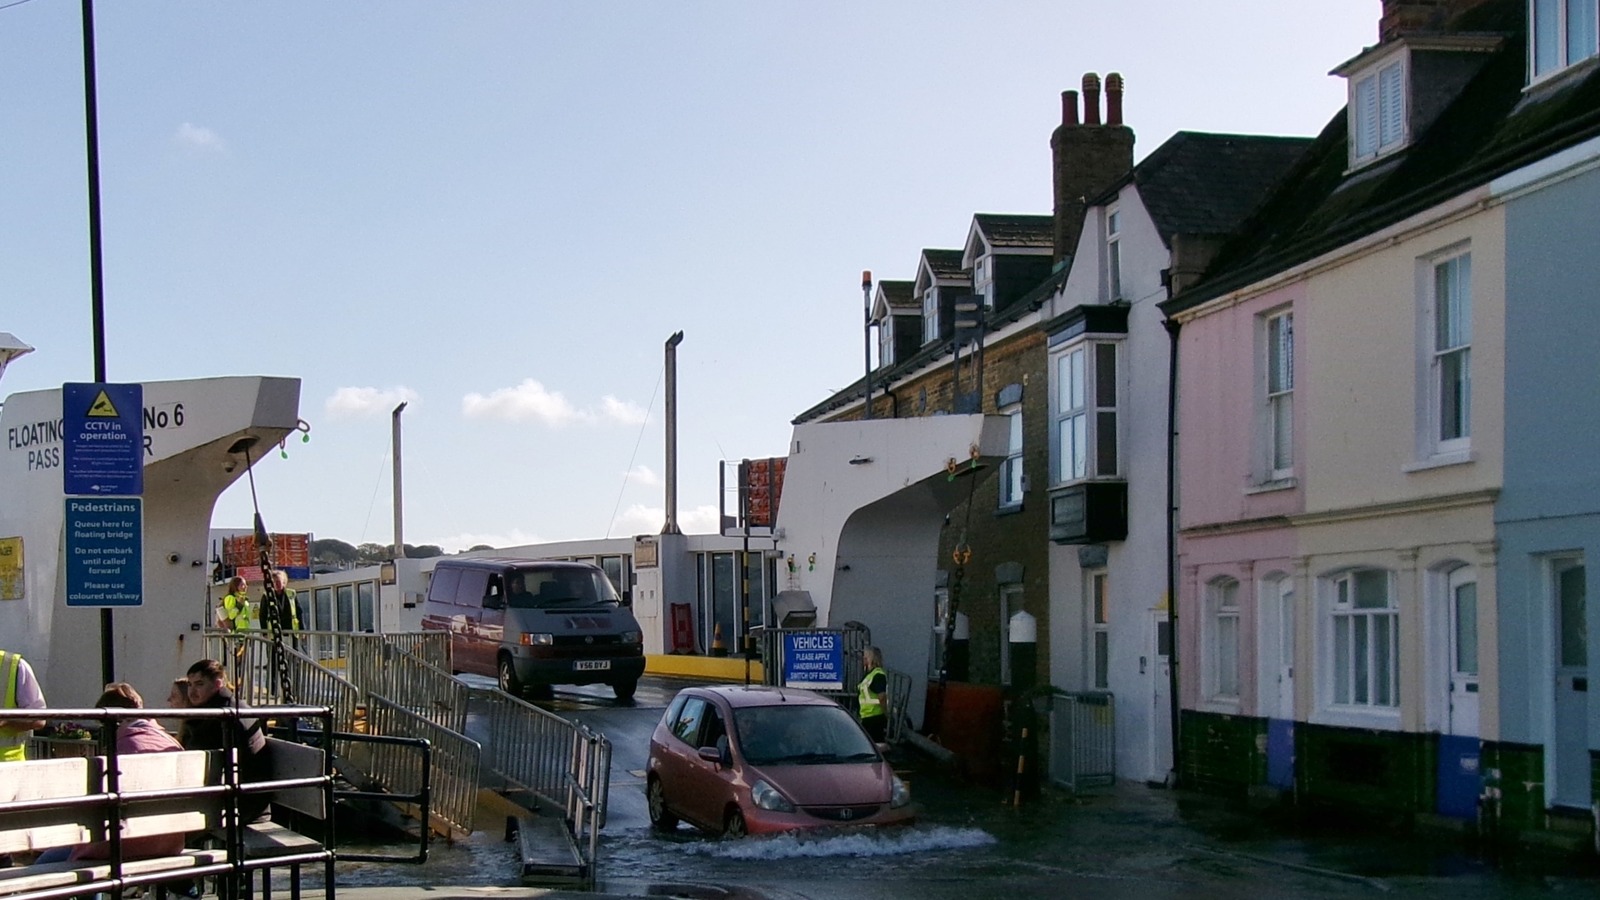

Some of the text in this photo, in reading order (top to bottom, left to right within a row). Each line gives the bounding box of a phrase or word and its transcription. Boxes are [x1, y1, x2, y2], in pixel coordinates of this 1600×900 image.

[143, 406, 168, 430] No
[174, 403, 184, 427] 6
[85, 422, 121, 430] CCTV in
[80, 432, 126, 441] operation
[71, 502, 136, 512] Pedestrians
[74, 520, 133, 528] Queue here for
[74, 531, 133, 539] floating bridge
[105, 593, 140, 601] walkway
[792, 636, 834, 649] VEHICLES
[793, 662, 834, 670] HANDBRAKE AND
[790, 672, 837, 680] SWITCH OFF ENGINE
